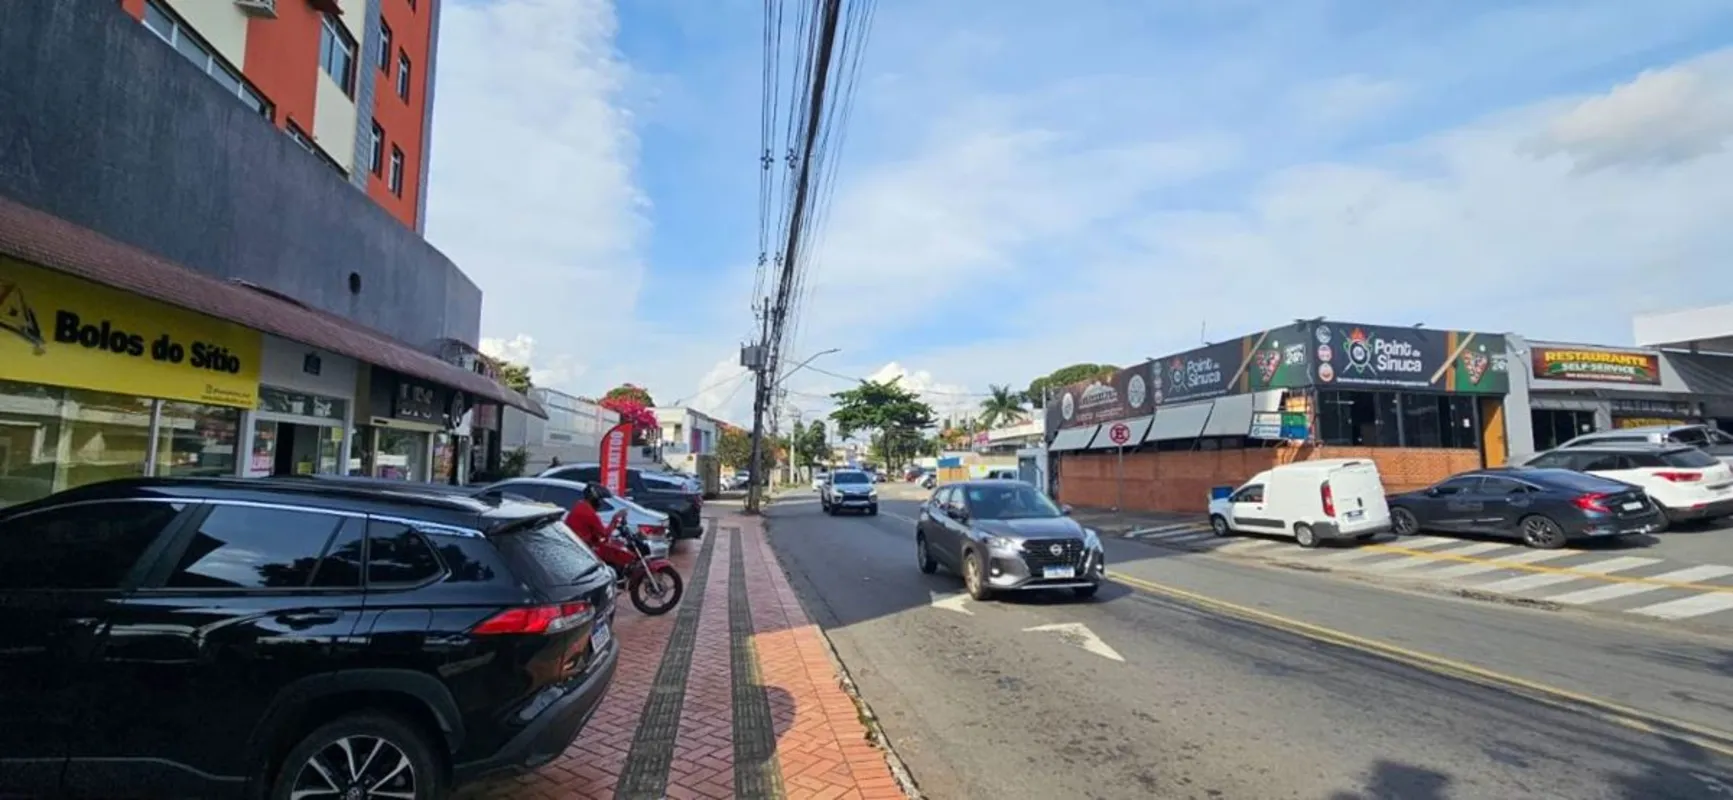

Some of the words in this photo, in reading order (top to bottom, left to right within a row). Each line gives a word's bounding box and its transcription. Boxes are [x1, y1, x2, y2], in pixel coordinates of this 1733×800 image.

[54, 310, 144, 357] Bolos
[152, 333, 184, 363] do
[190, 340, 240, 374] Sítio
[1374, 338, 1411, 357] Point
[1186, 359, 1213, 374] Point
[1377, 354, 1422, 372] Sinuca
[1544, 351, 1648, 367] RESTAURANTE
[1561, 362, 1636, 374] SELF-SERVICE
[1187, 371, 1221, 387] Sinuca
